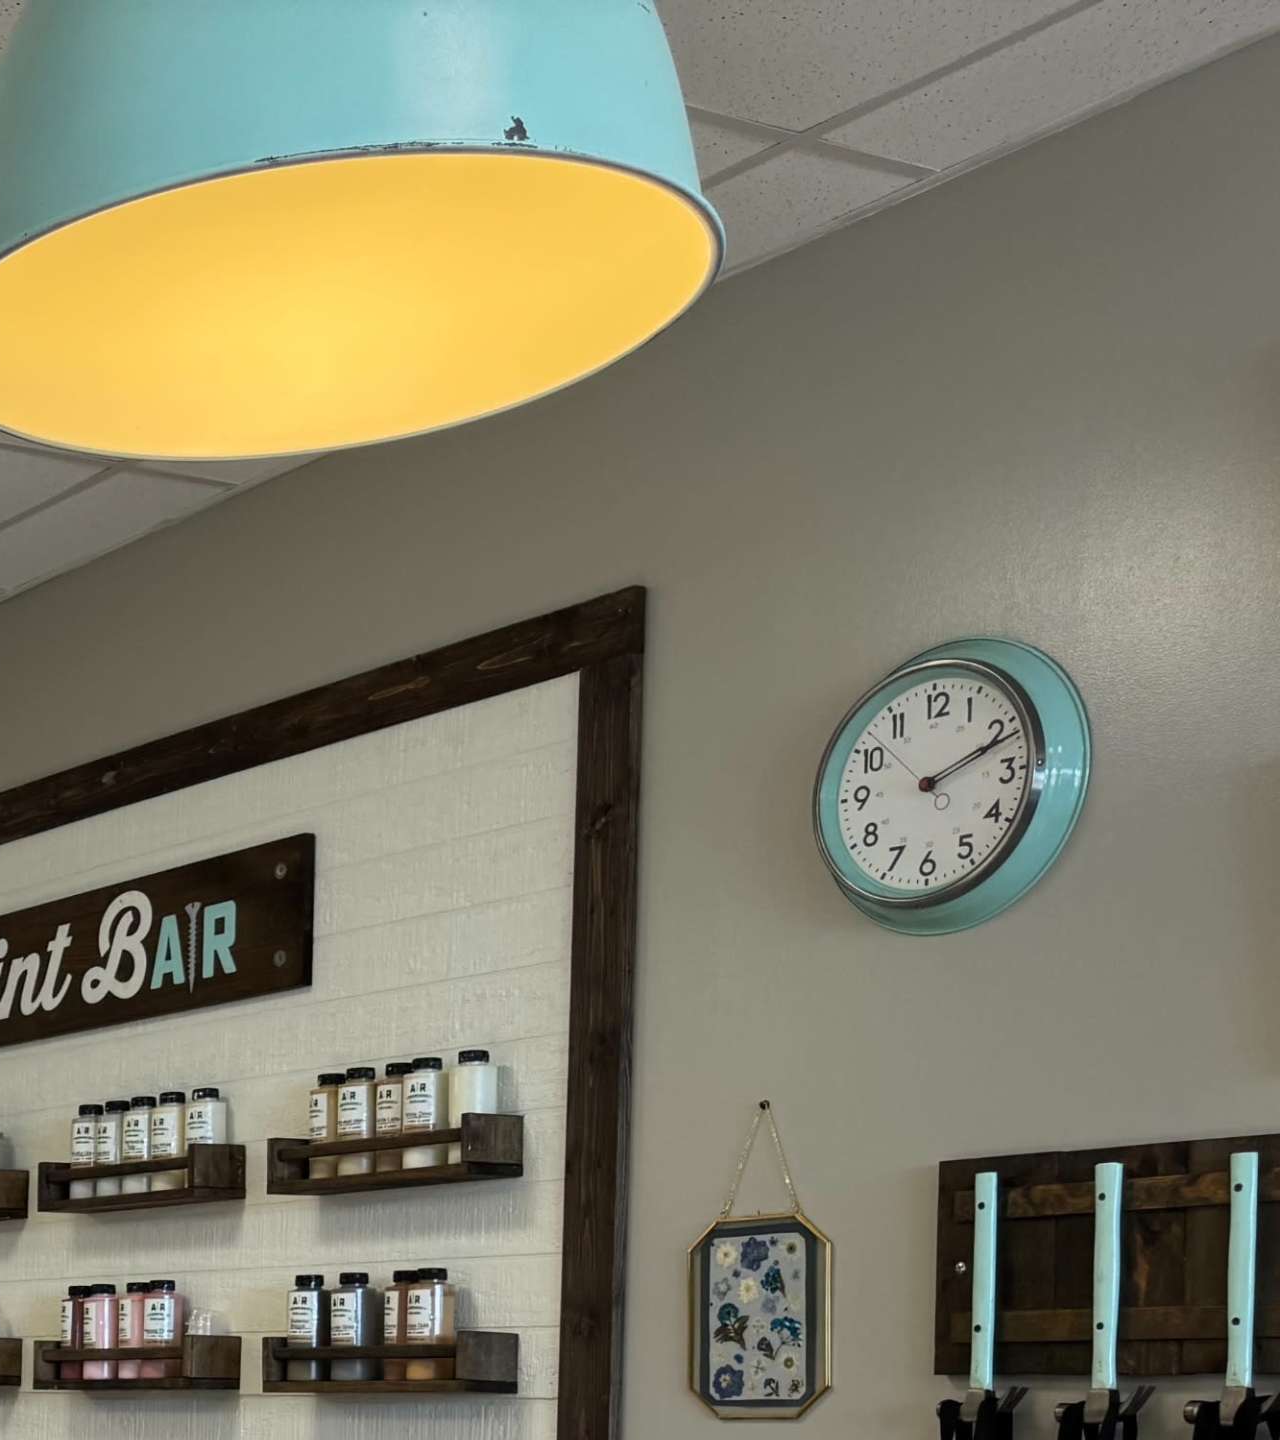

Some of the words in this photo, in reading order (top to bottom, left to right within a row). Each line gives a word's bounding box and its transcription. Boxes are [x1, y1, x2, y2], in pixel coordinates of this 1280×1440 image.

[927, 692, 950, 719] 12
[968, 697, 973, 722] 1
[892, 713, 904, 739] 11
[988, 719, 1005, 745] 2
[864, 747, 883, 773] 10
[999, 757, 1016, 784] 3
[854, 786, 870, 811] 9
[983, 799, 1002, 823] 4
[863, 822, 878, 847] 8
[957, 834, 973, 859] 5
[888, 845, 906, 872] 7
[919, 851, 936, 876] 6
